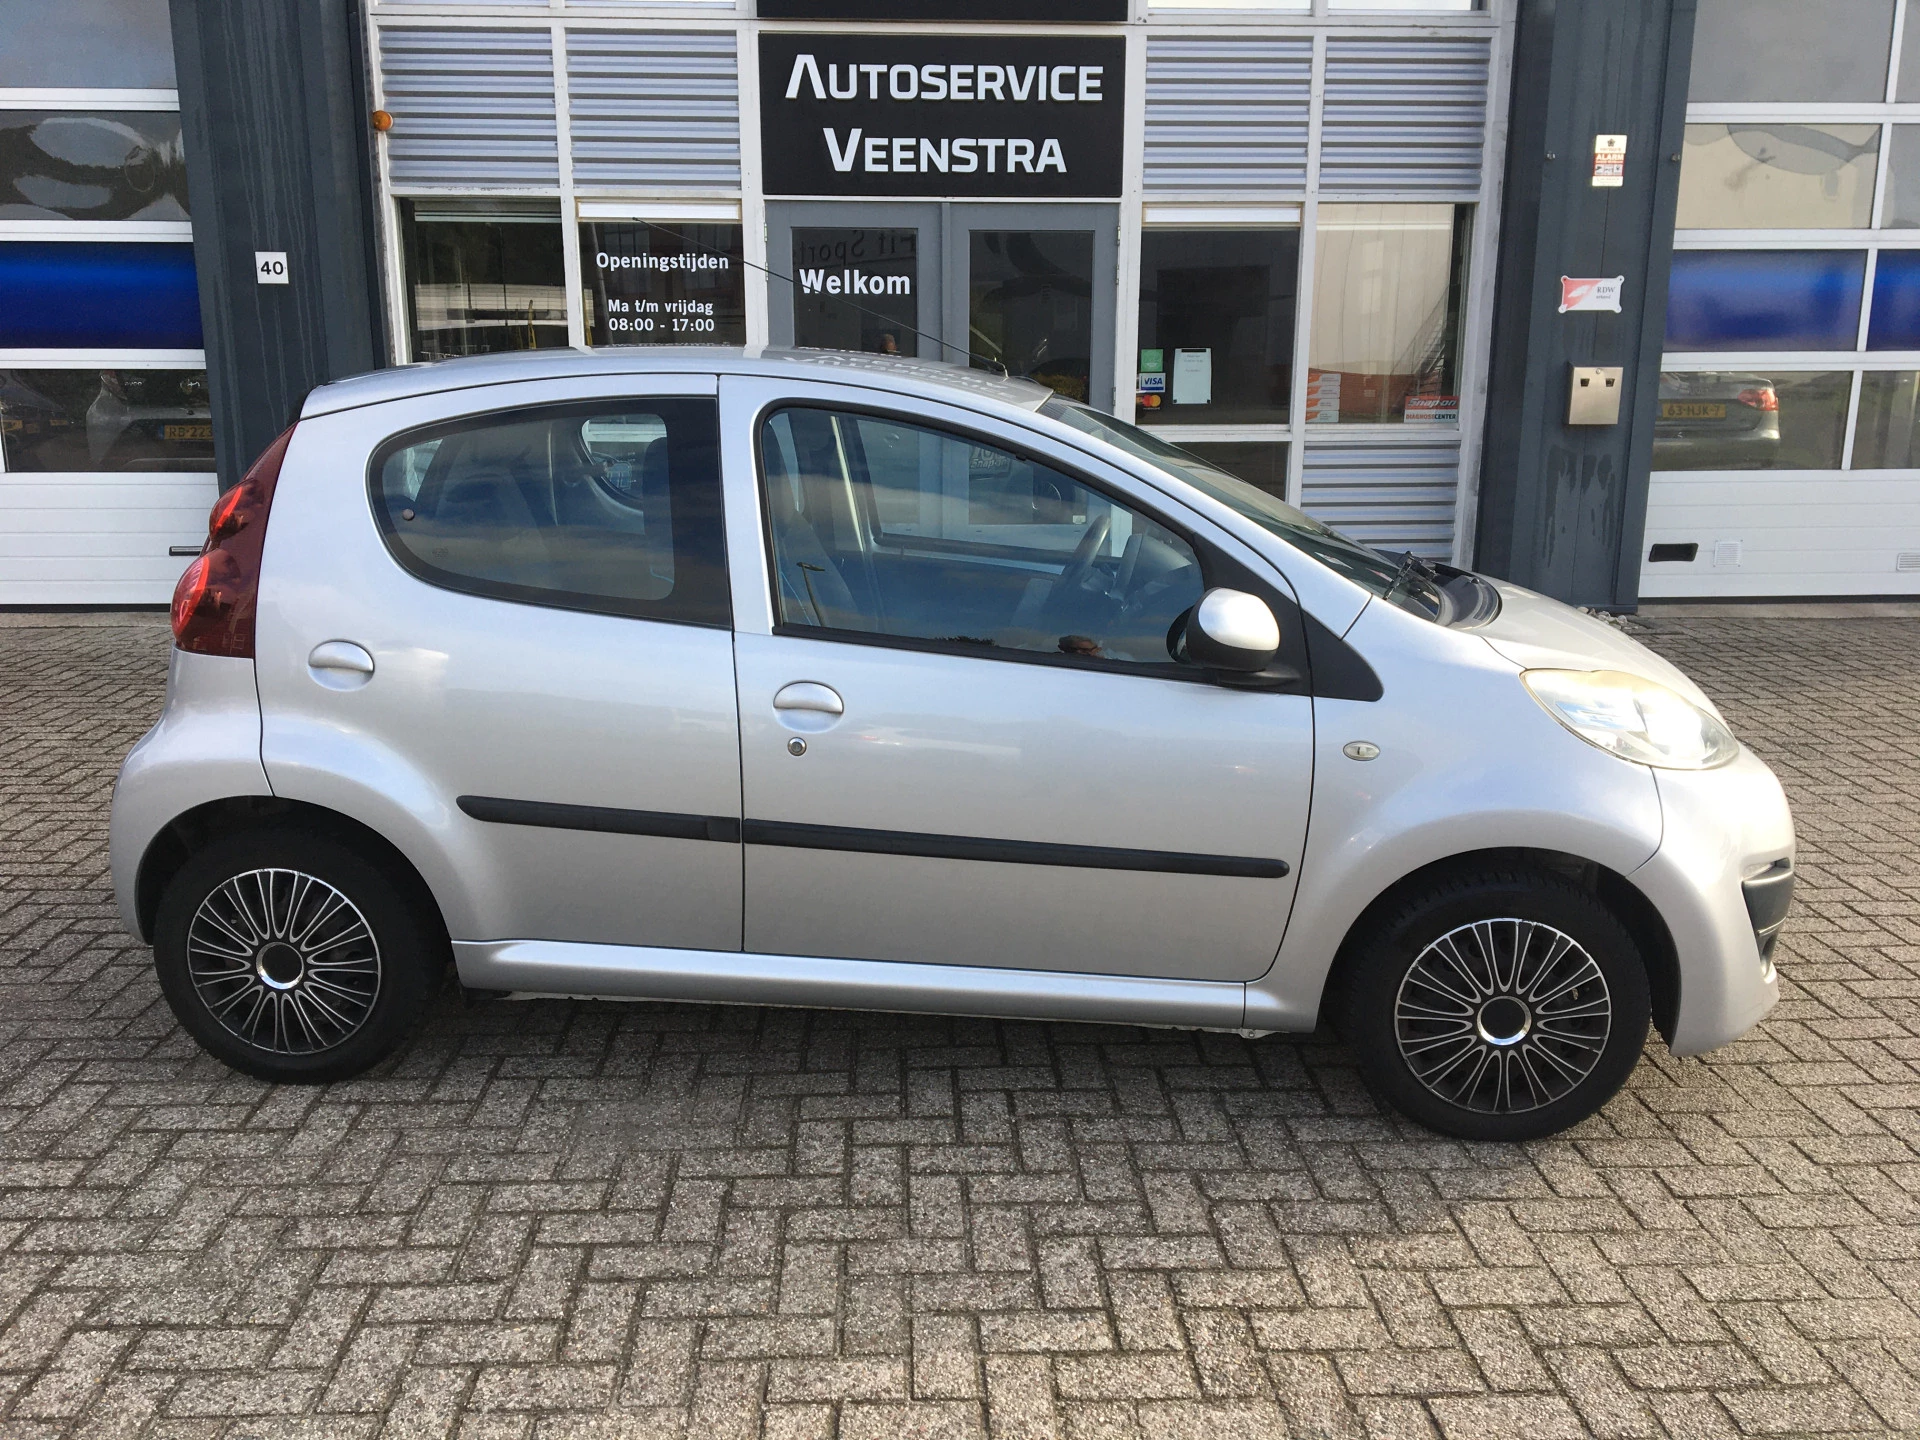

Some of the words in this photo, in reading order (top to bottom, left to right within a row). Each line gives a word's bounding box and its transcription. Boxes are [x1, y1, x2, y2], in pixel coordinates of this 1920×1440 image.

[785, 54, 1104, 101] AUTOSERVICE
[823, 128, 1067, 173] VEENSTRA
[260, 261, 284, 275] 40
[596, 252, 729, 272] Openingstijden
[799, 268, 911, 295] Welkom
[608, 299, 629, 312] Ma
[634, 299, 659, 313] t/m
[664, 300, 713, 316] vrijdag
[608, 318, 654, 331] 08:00
[672, 318, 715, 332] 17:00
[1144, 377, 1163, 385] VISA
[1407, 397, 1457, 408] Snap-on
